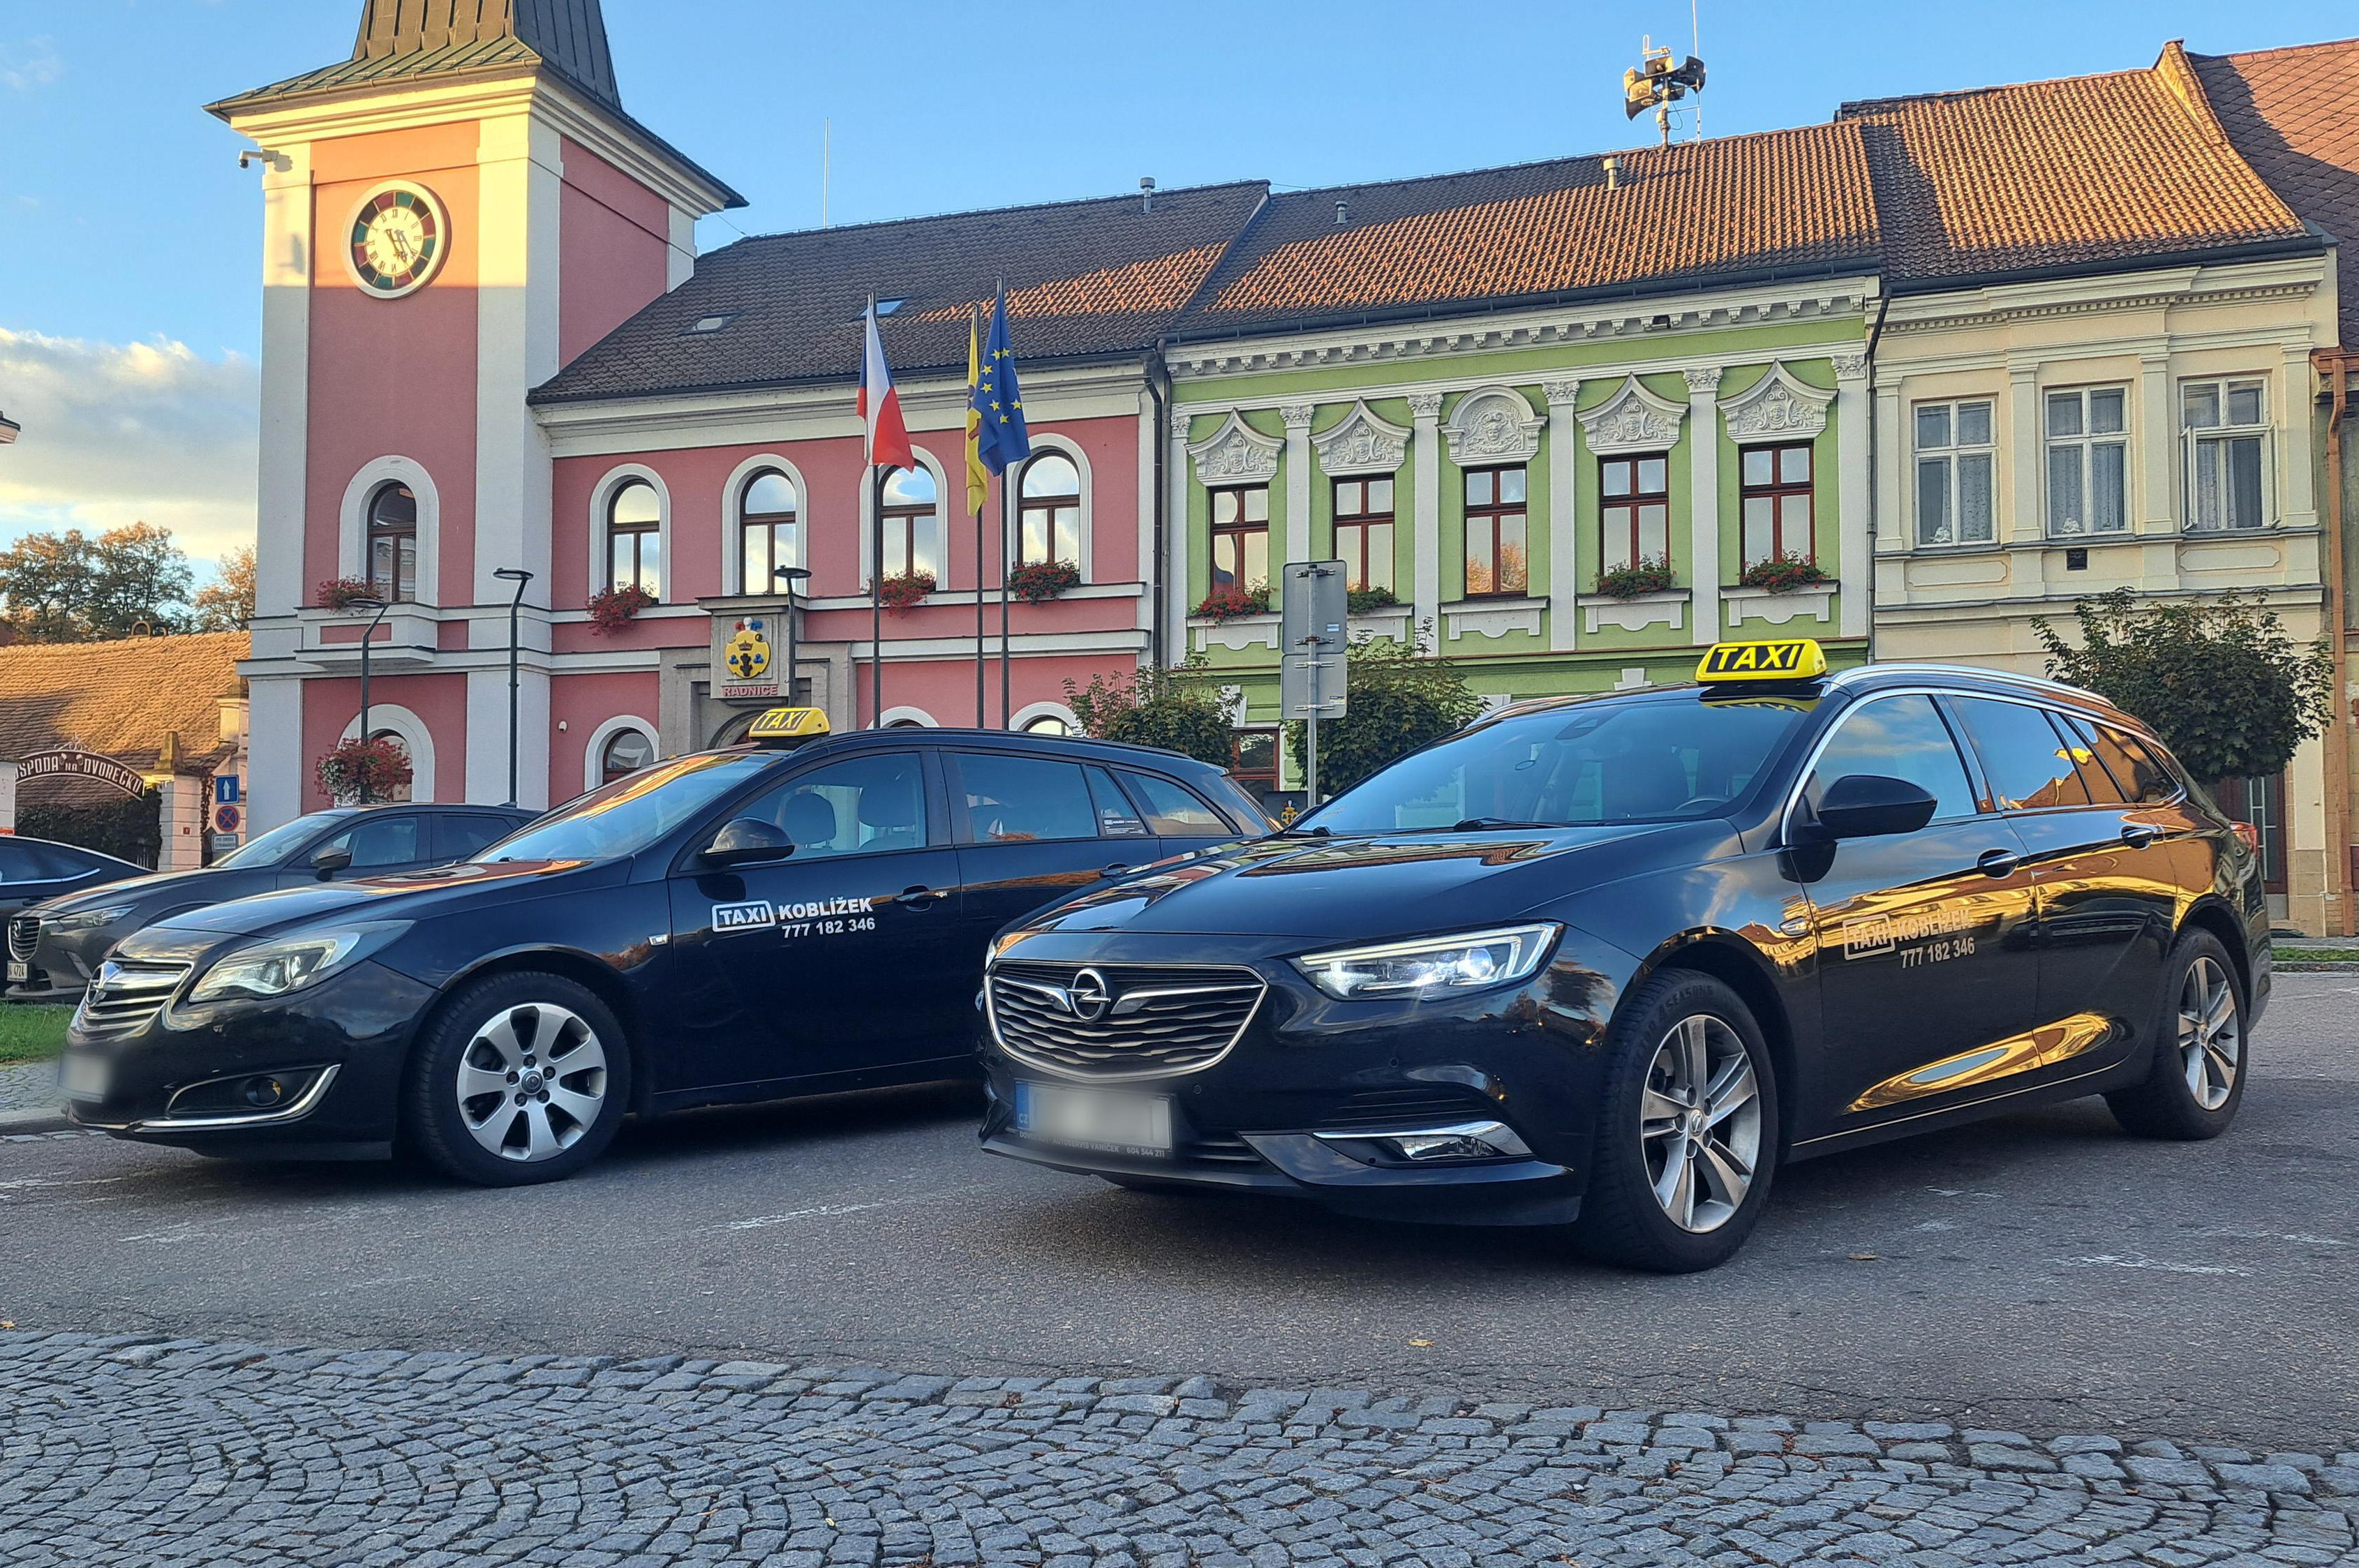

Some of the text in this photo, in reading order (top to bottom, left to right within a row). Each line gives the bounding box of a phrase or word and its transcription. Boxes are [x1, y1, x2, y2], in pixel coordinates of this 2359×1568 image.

[1717, 645, 1801, 671] TAXI
[722, 686, 778, 697] RADNICE
[759, 712, 808, 729] TAXI
[83, 759, 142, 793] DVOREČKU
[719, 897, 874, 926] TAXI KOBLÍŽEK
[782, 917, 876, 939] 777 182 346
[1852, 922, 1893, 950] TAXI
[1900, 936, 1975, 969] 777 182 346
[1019, 1113, 1028, 1123] CZ
[1089, 1142, 1119, 1153] VANÍČEK
[1126, 1147, 1140, 1155] 604
